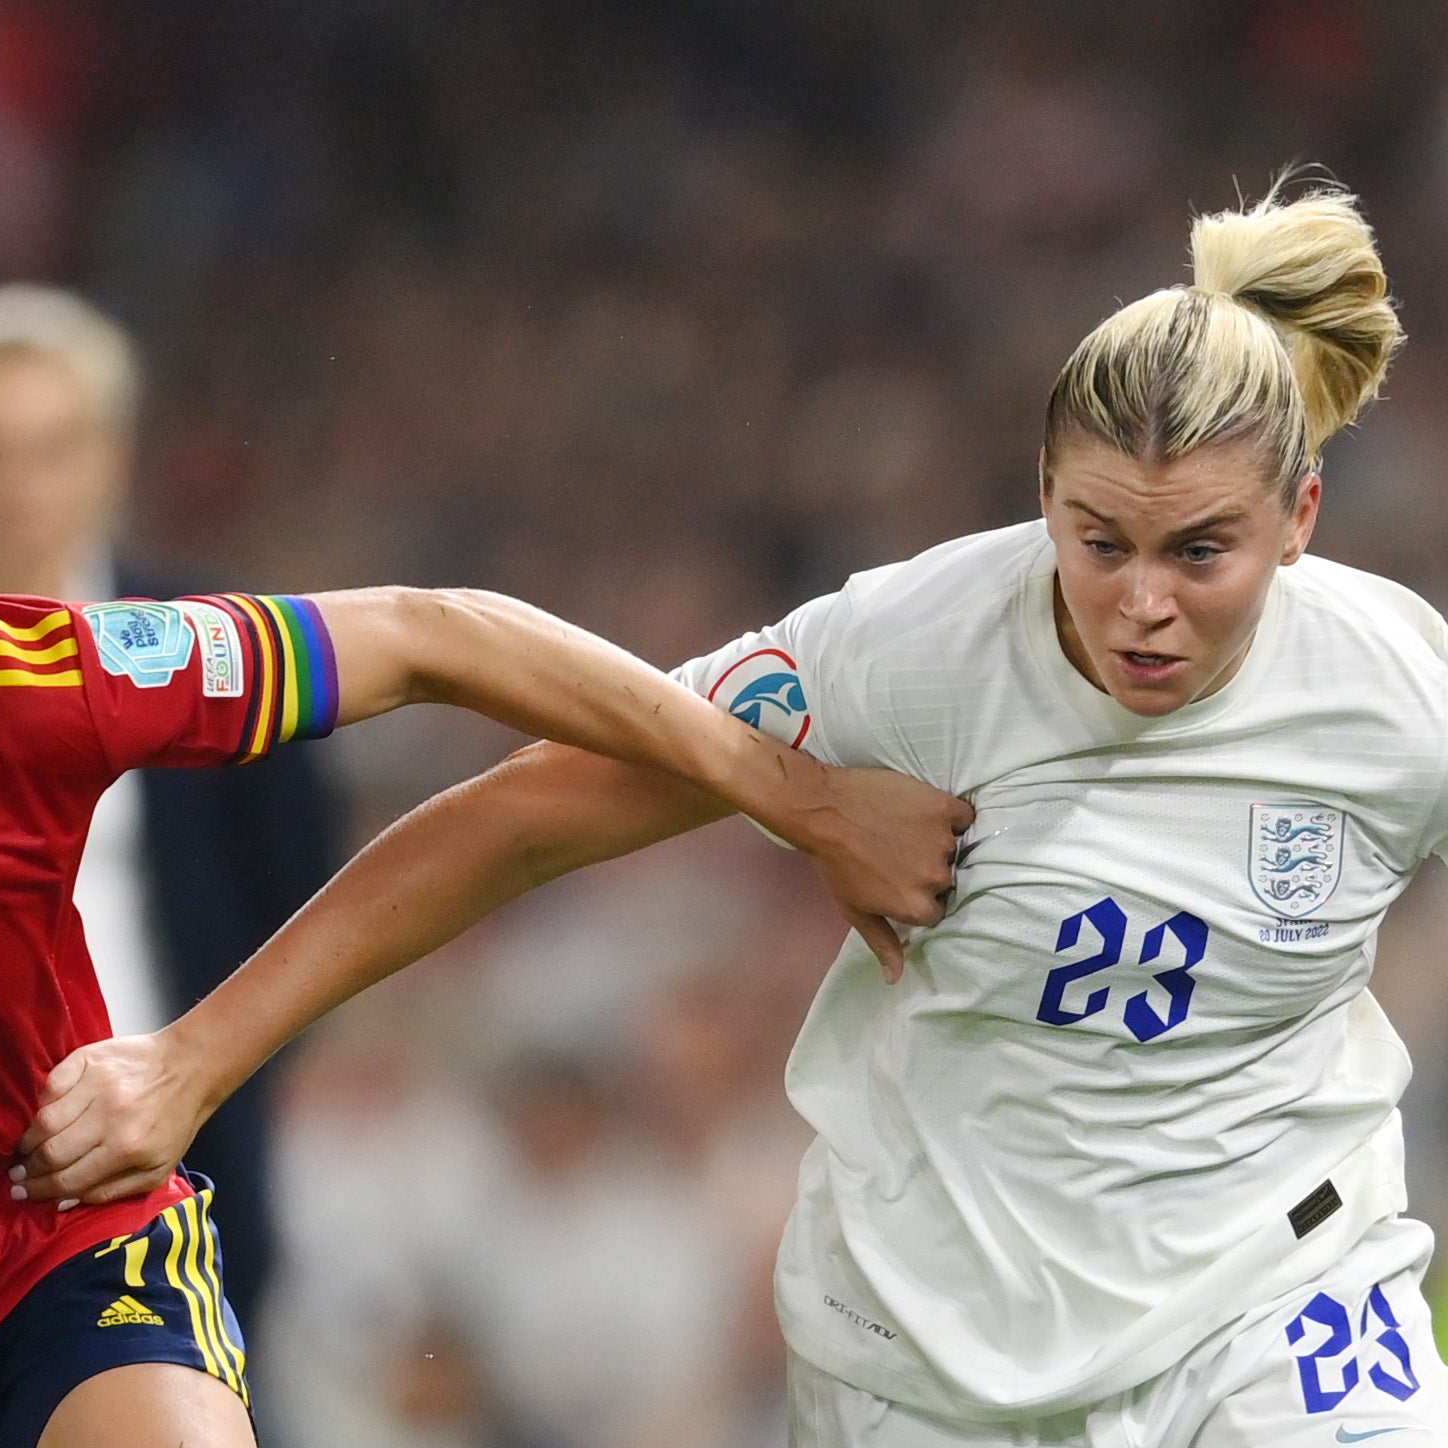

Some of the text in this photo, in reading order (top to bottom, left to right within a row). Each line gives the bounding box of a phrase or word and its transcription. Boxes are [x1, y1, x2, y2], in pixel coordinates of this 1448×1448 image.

[1036, 896, 1210, 1043] 23
[1259, 922, 1329, 942] 20 JULY 2022
[97, 1312, 165, 1327] adidas
[1285, 1282, 1421, 1414] 23
